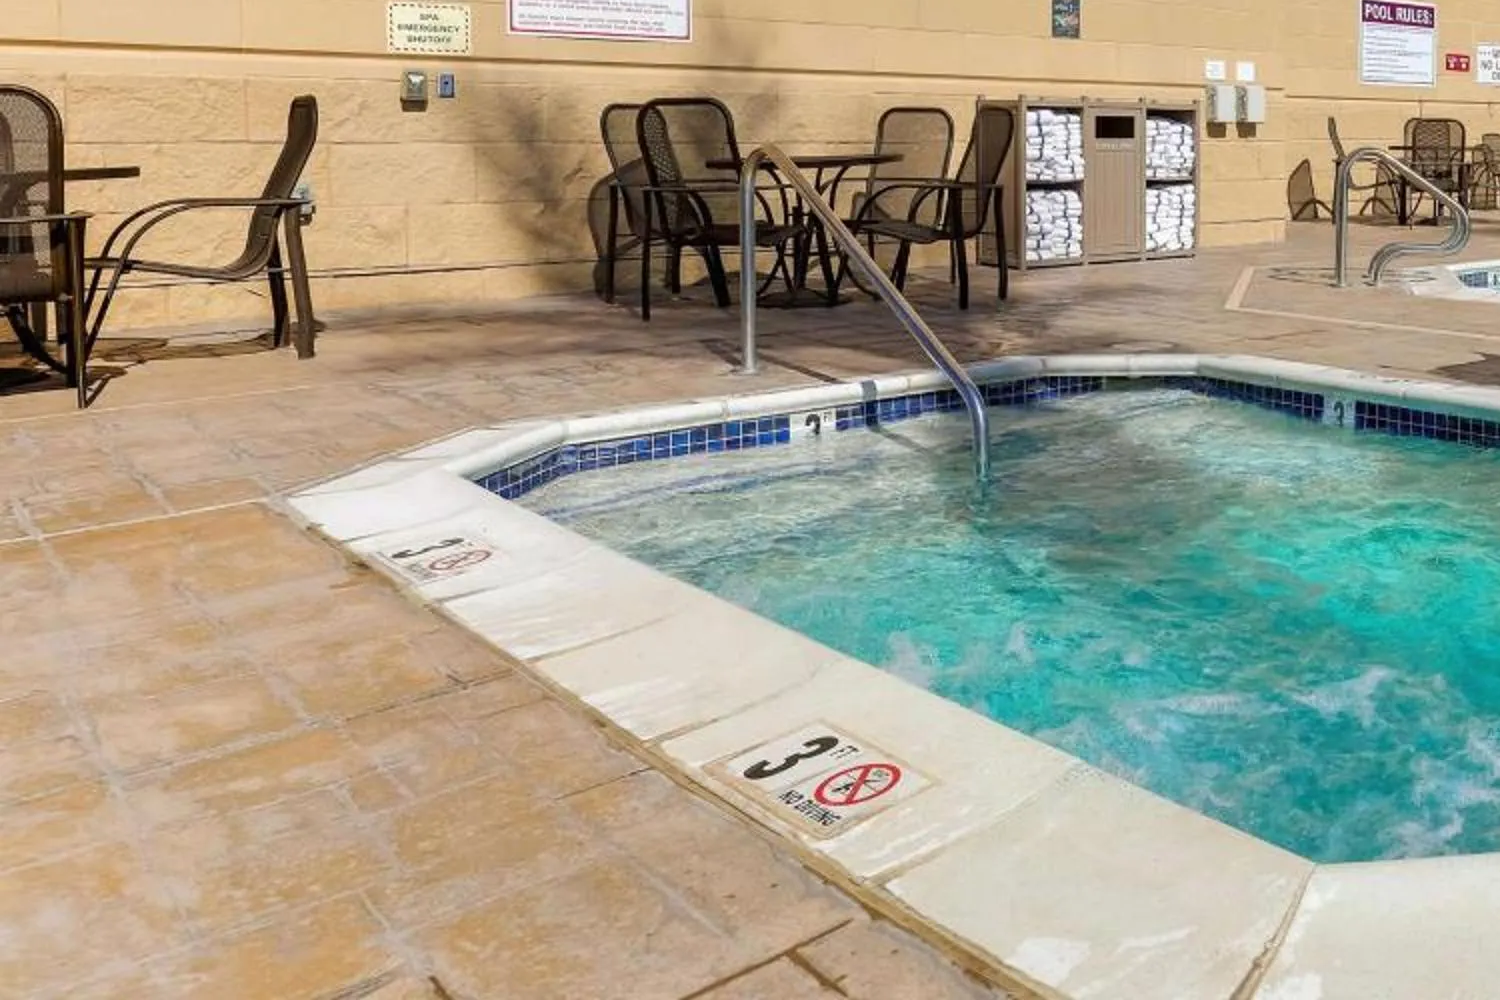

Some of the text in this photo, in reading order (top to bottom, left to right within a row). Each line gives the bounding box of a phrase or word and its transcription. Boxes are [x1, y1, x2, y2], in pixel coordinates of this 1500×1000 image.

[419, 13, 439, 21] SPA
[1365, 3, 1433, 25] POOL RULES:
[397, 23, 461, 33] EMERGENCY
[1480, 60, 1493, 71] NO
[743, 736, 839, 780] 3
[778, 790, 804, 804] NO
